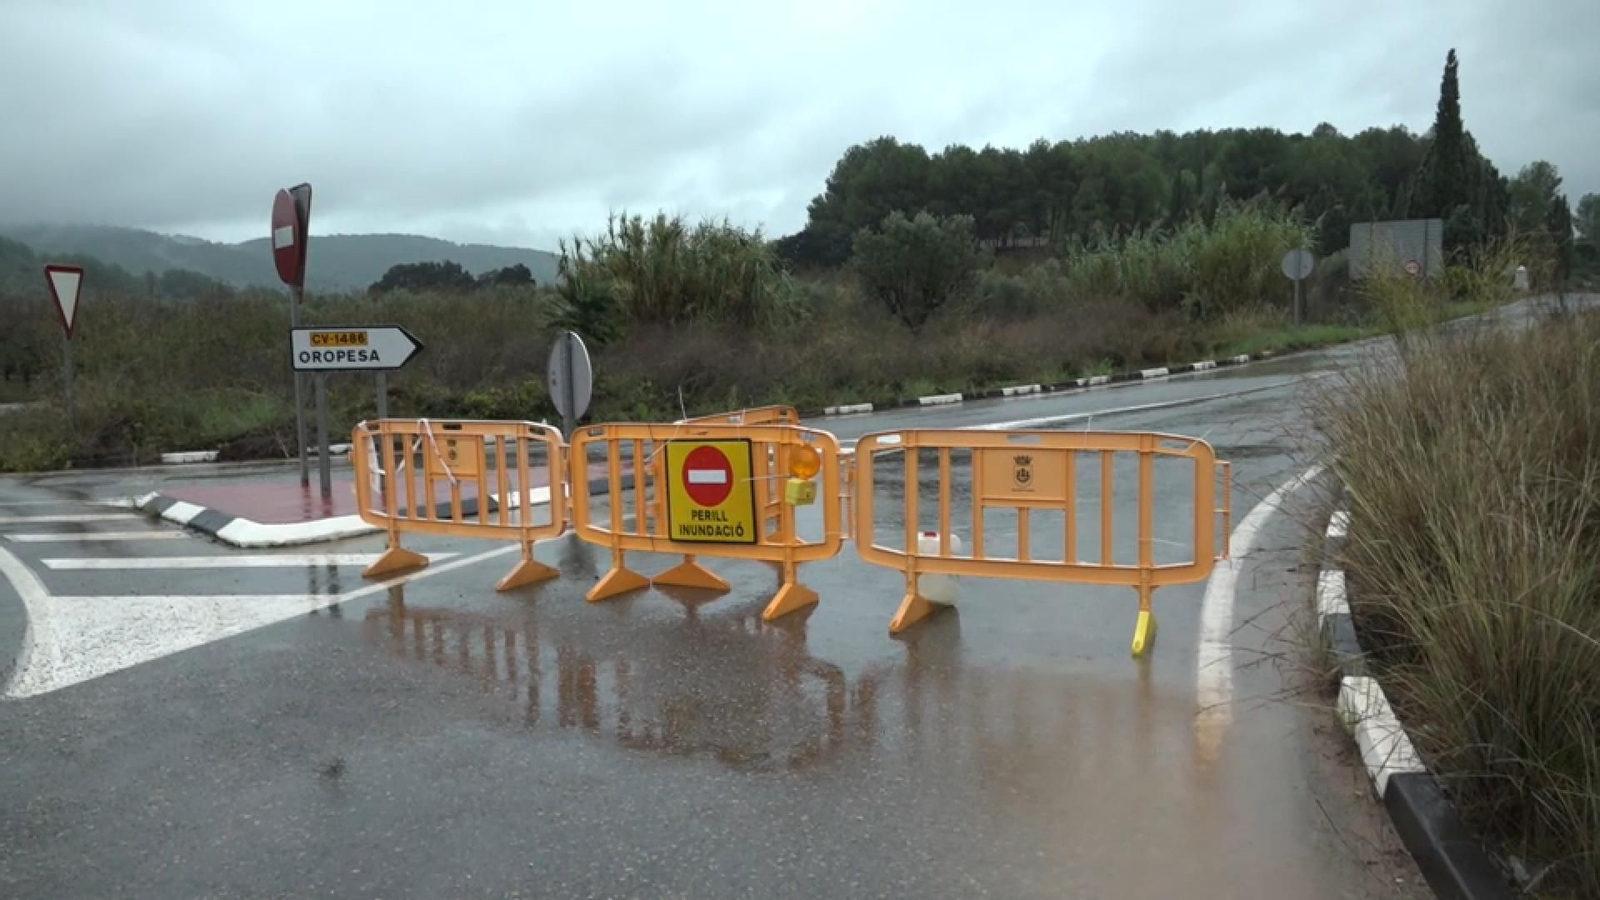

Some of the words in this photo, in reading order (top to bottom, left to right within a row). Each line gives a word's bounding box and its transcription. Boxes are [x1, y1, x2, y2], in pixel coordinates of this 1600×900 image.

[311, 332, 367, 345] CV-1486
[299, 350, 380, 363] OROPESA
[691, 509, 728, 522] PERILL
[679, 521, 744, 537] INUNDACIÓ
